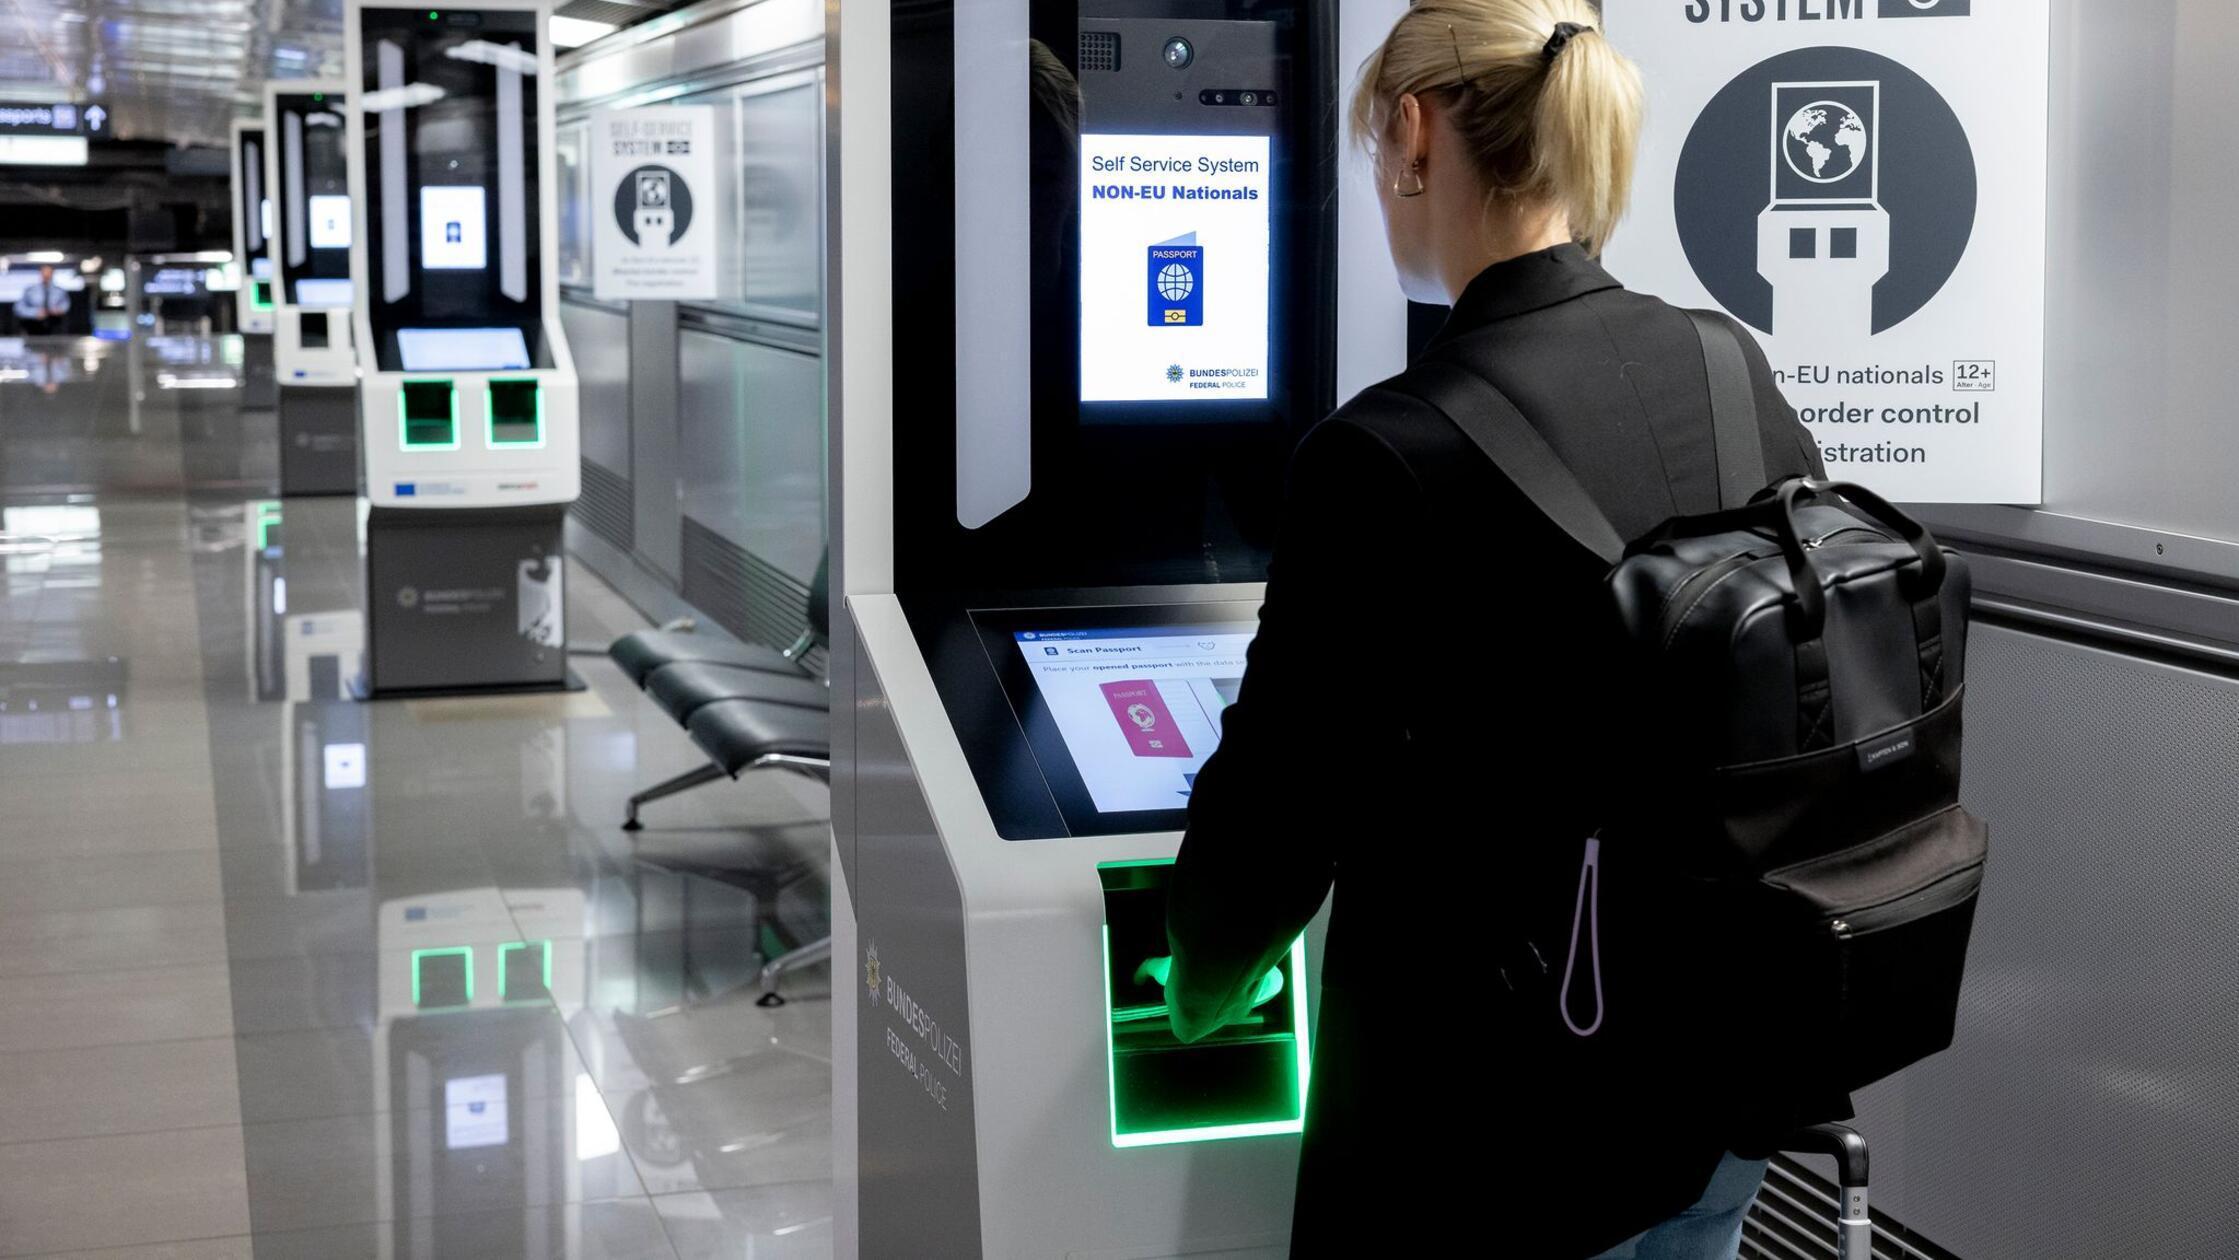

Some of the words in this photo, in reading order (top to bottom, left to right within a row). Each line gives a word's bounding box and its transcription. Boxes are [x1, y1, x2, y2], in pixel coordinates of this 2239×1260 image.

[1092, 156, 1125, 171] Self
[1130, 156, 1192, 172] Service
[1198, 157, 1259, 175] System
[1092, 185, 1166, 199] NON-EU
[1172, 186, 1259, 200] Nationals
[1189, 369, 1259, 377] BUNDESPOLIZEI
[1773, 366, 1830, 384] n-EU
[1837, 365, 1944, 384] nationals
[1957, 364, 1991, 379] 12+
[1800, 401, 1874, 423] order
[1881, 402, 1979, 423] control
[1095, 646, 1142, 654] Passport
[1093, 663, 1129, 671] opened
[1131, 661, 1173, 669] passport
[887, 975, 962, 1078] BUNDESPOLIZEI
[887, 1027, 919, 1079] FEDERAL
[920, 1063, 948, 1111] POLICE
